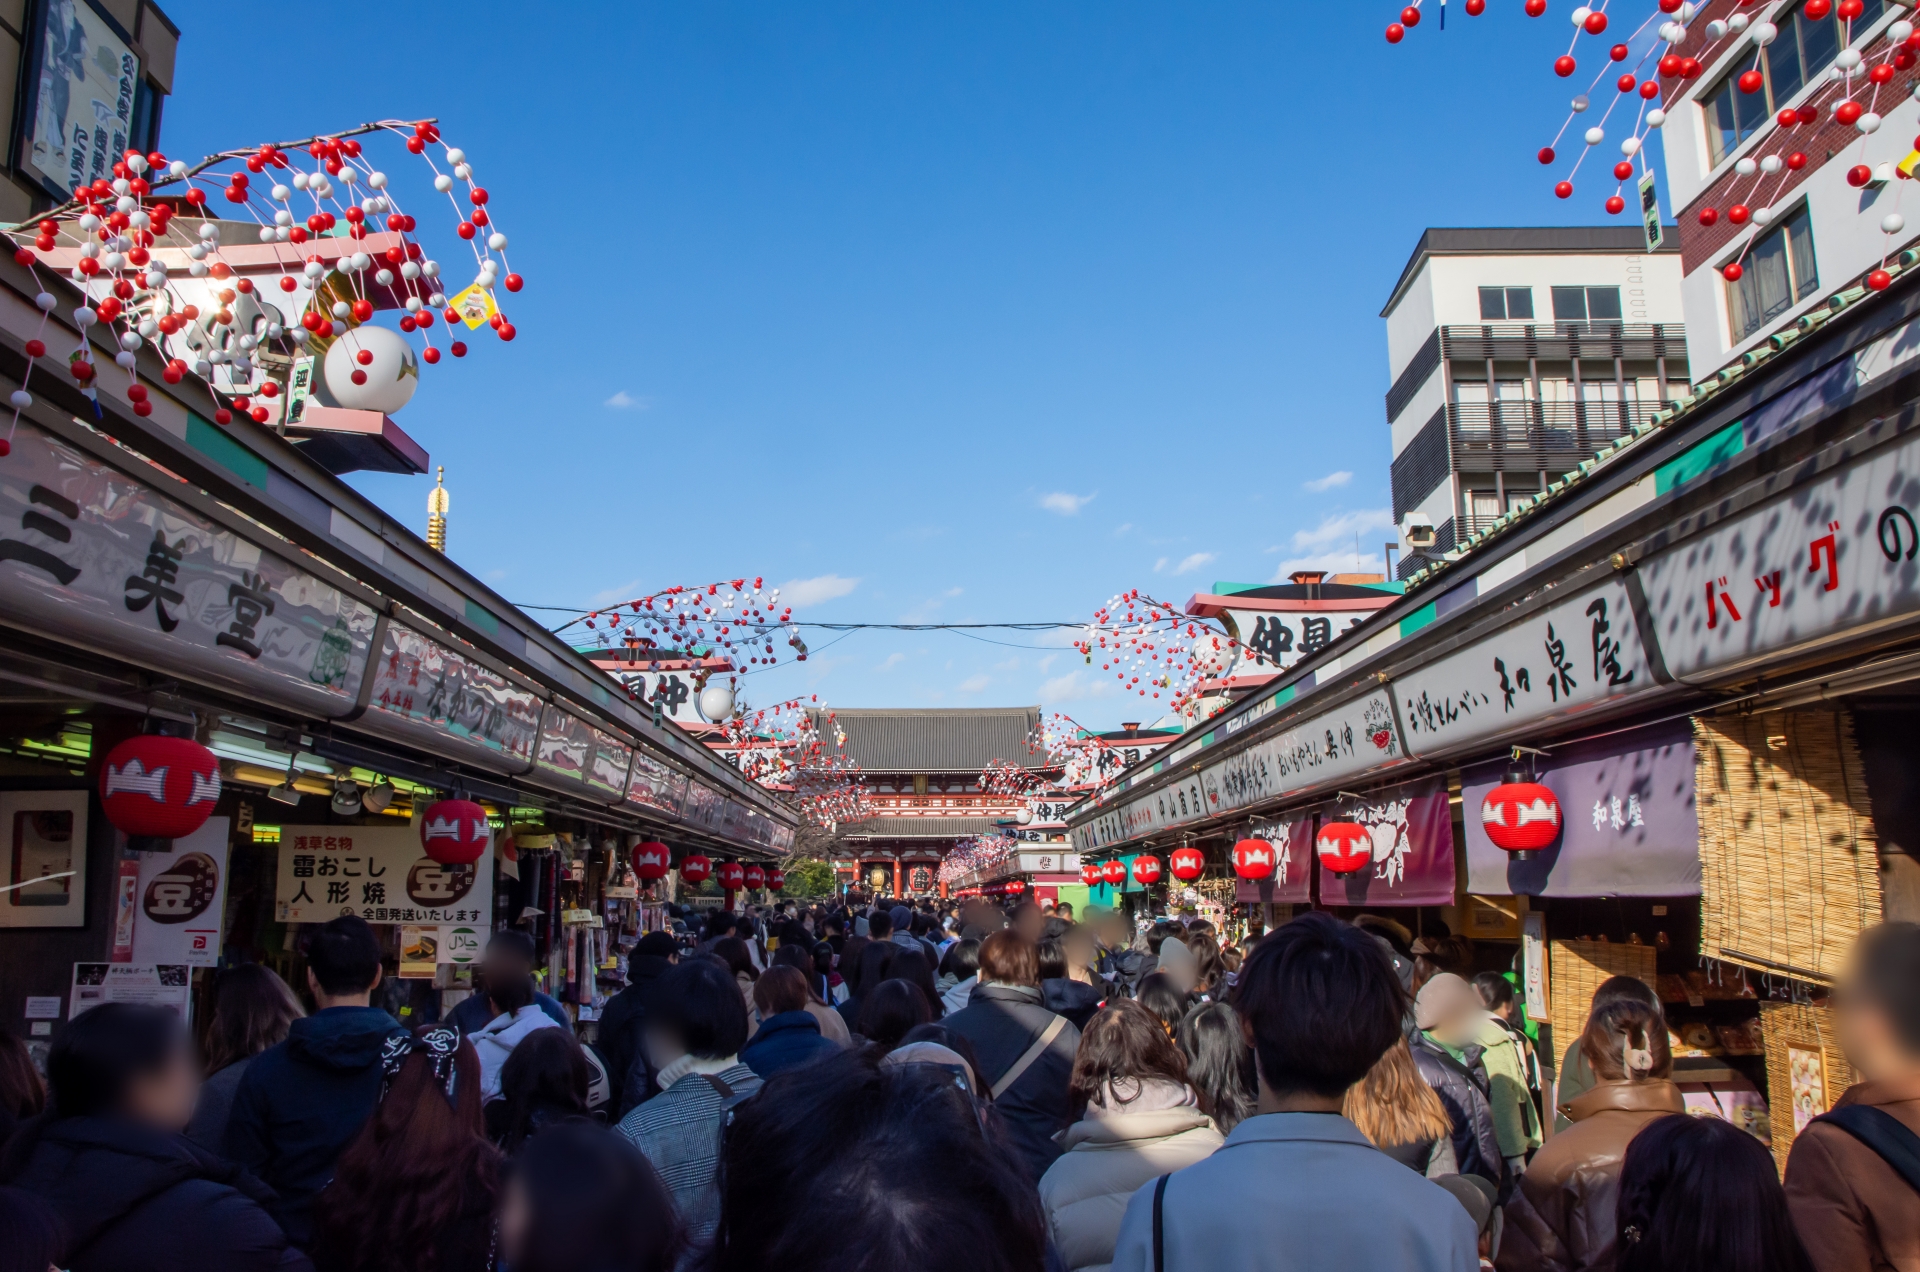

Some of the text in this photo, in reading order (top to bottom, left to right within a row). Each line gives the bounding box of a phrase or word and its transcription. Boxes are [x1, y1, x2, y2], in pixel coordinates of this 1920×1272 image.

[90, 123, 109, 187] 浅草
[0, 484, 275, 659] 三美堂
[1705, 505, 1920, 630] バッグの
[1249, 615, 1362, 667] 仲見
[1494, 597, 1634, 714] 和泉屋
[1592, 793, 1645, 832] 和泉屋
[293, 836, 353, 850] 浅草名物
[205, 866, 216, 900] 仲見世
[293, 855, 387, 878] 雷おこし
[412, 859, 455, 899] 豆
[149, 874, 195, 915] 豆
[291, 881, 386, 904] 人形焼
[362, 908, 481, 922] 全国発送いたします
[448, 935, 478, 950] حلال
